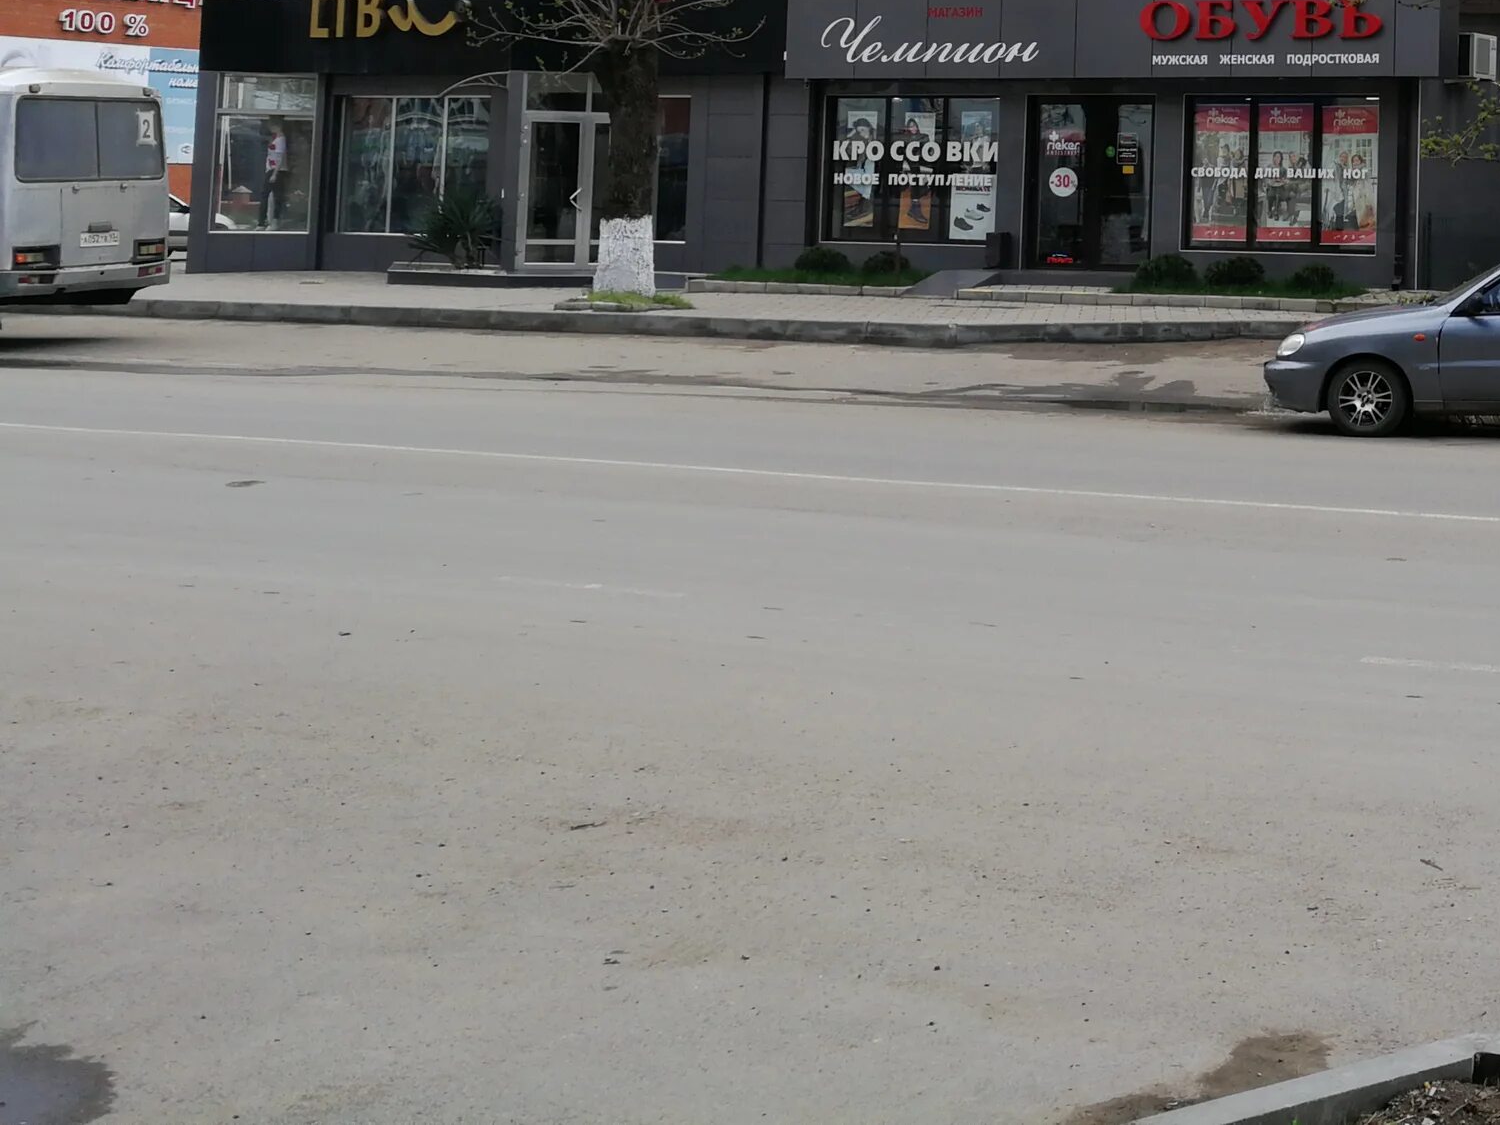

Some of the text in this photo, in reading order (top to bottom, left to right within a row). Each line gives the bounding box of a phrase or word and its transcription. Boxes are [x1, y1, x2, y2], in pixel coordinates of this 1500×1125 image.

[927, 6, 983, 19] МАГАЗИН
[60, 8, 149, 37] 100 %
[820, 15, 1039, 64] Чемпион
[1152, 53, 1380, 66] МУЖСКАЯ ЖЕНСКАЯ ПОДРОСТКОВАЯ
[142, 118, 151, 139] 2
[833, 173, 993, 187] НОВОЕ ПОСТУПЛЕНИЕ
[1191, 167, 1368, 179] СВОБОДА ДЛЯ ВАШИХ НОГ
